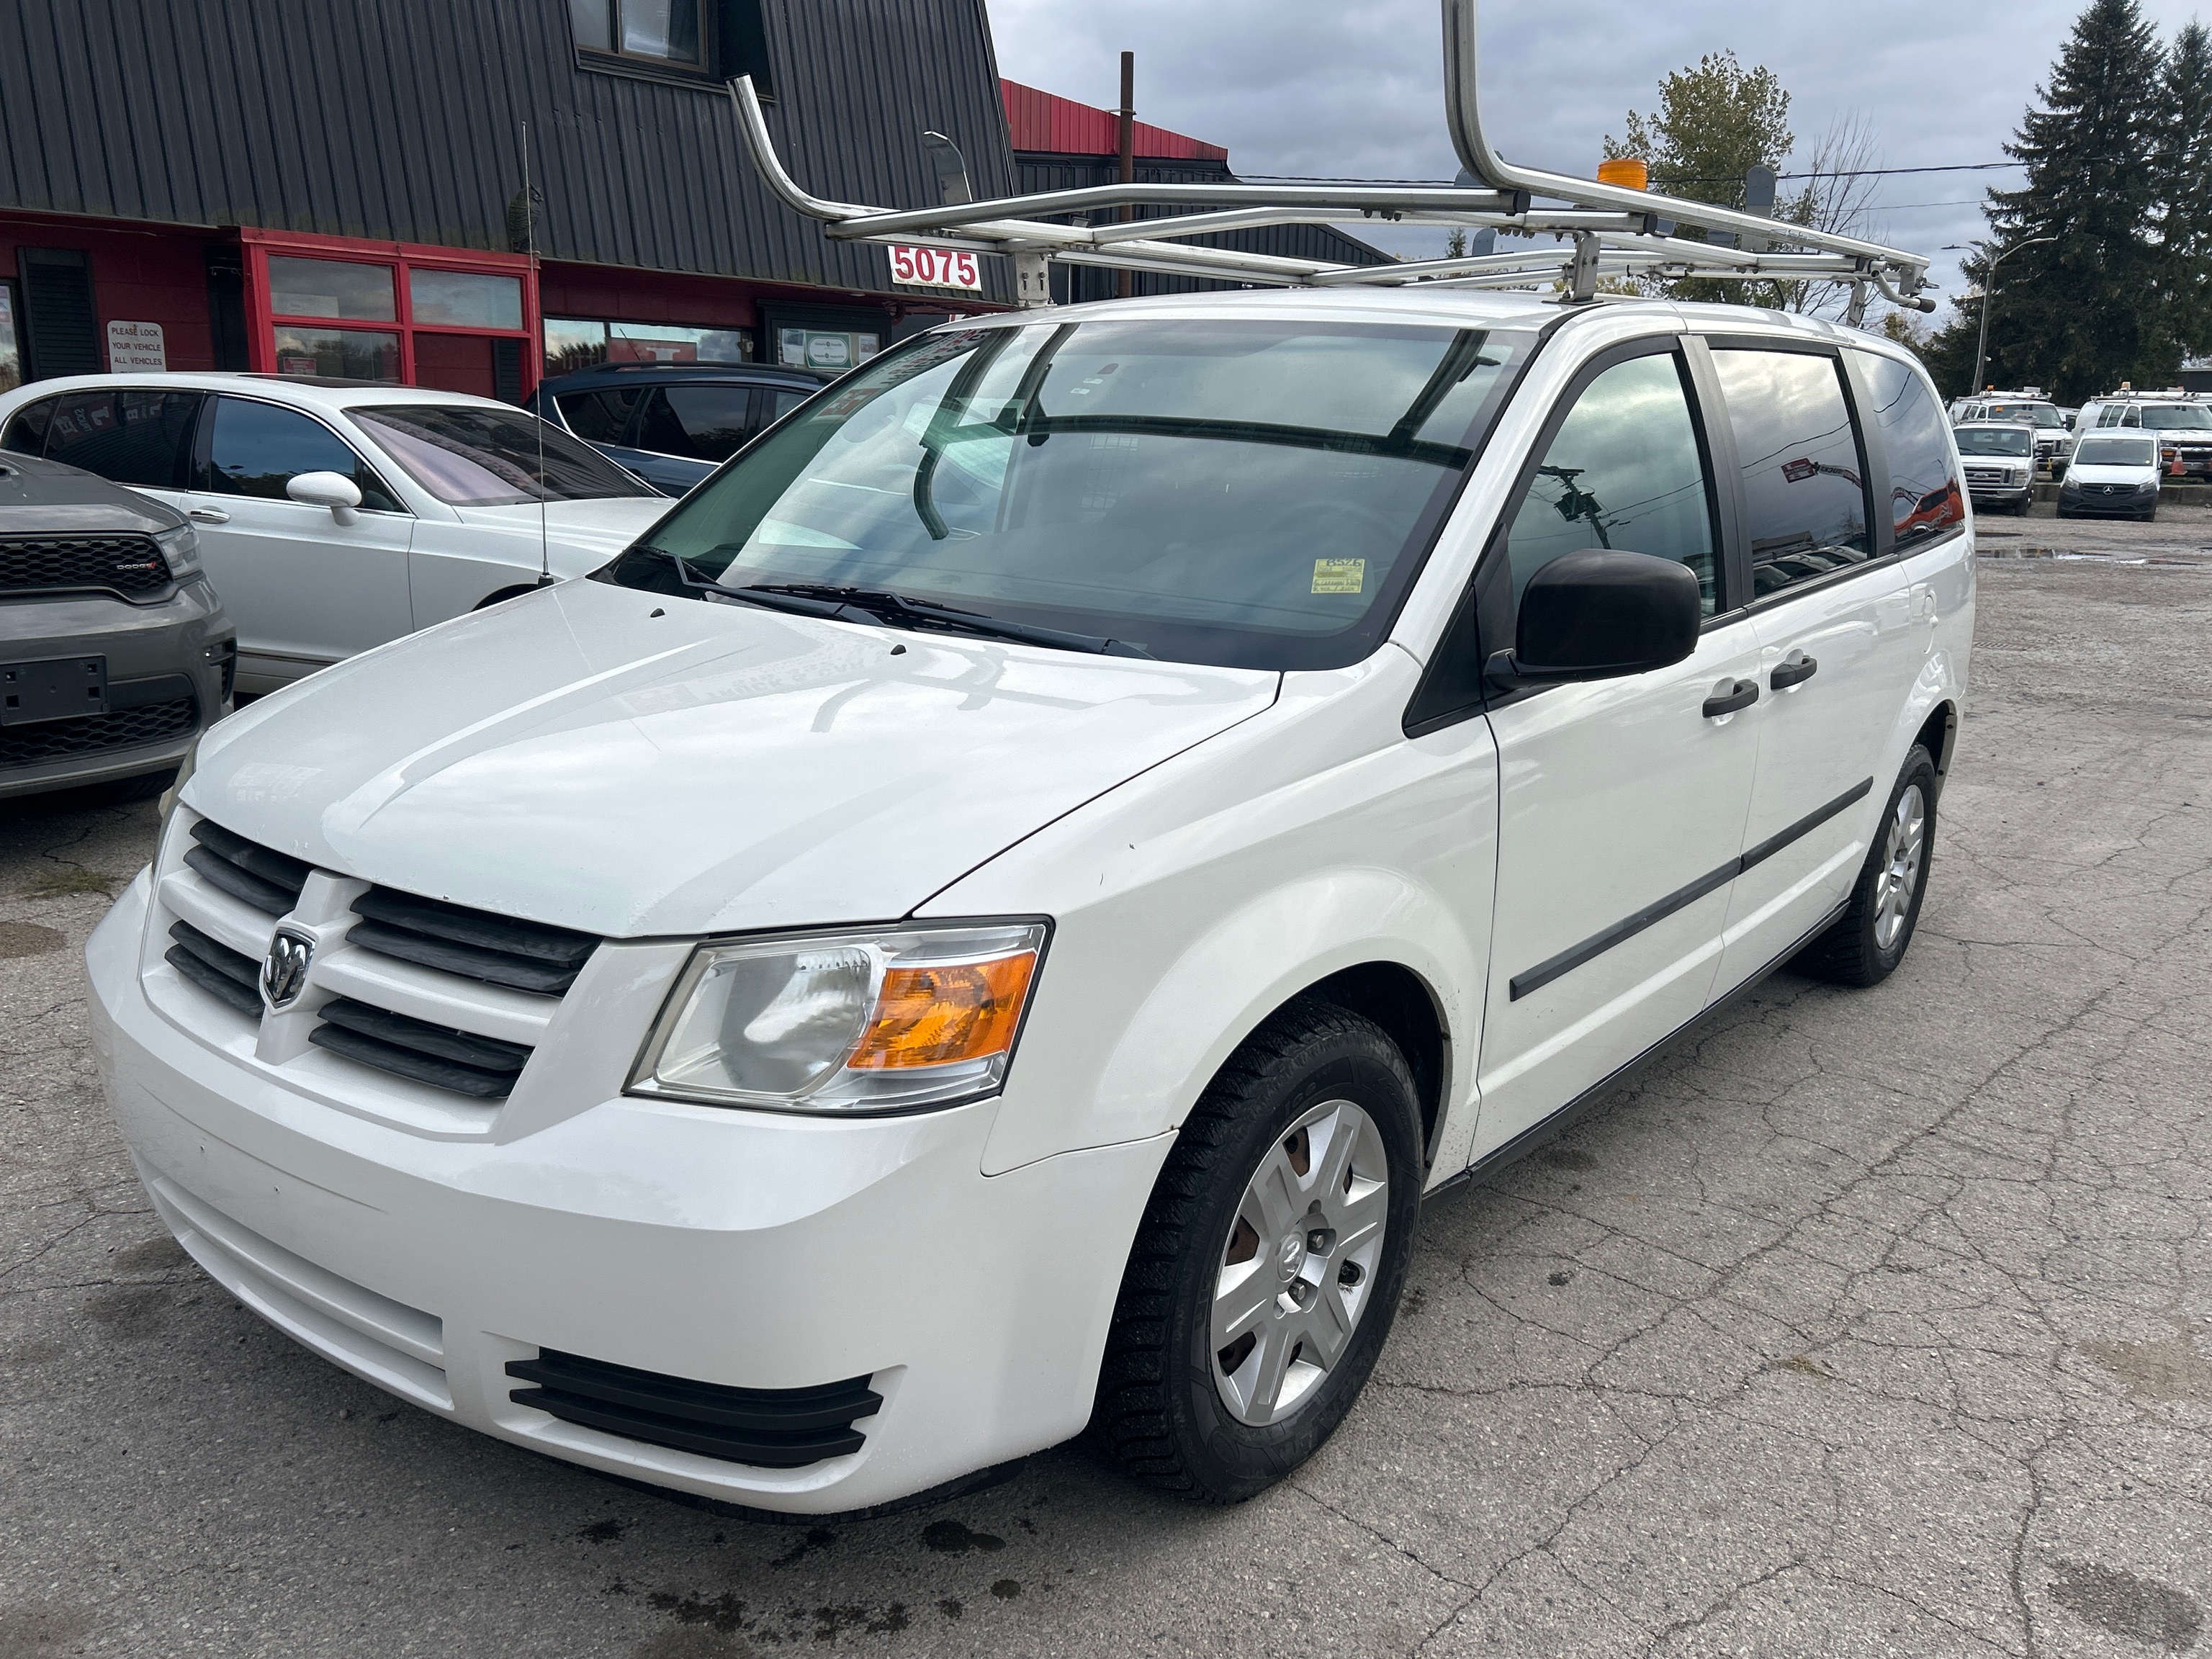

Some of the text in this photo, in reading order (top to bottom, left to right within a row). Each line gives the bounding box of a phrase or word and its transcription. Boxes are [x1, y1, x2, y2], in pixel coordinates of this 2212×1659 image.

[894, 246, 976, 286] 5075
[112, 327, 138, 336] PLEASE
[112, 341, 162, 352] YOUR VEHICLE
[114, 356, 163, 366] ALL VEHICLES
